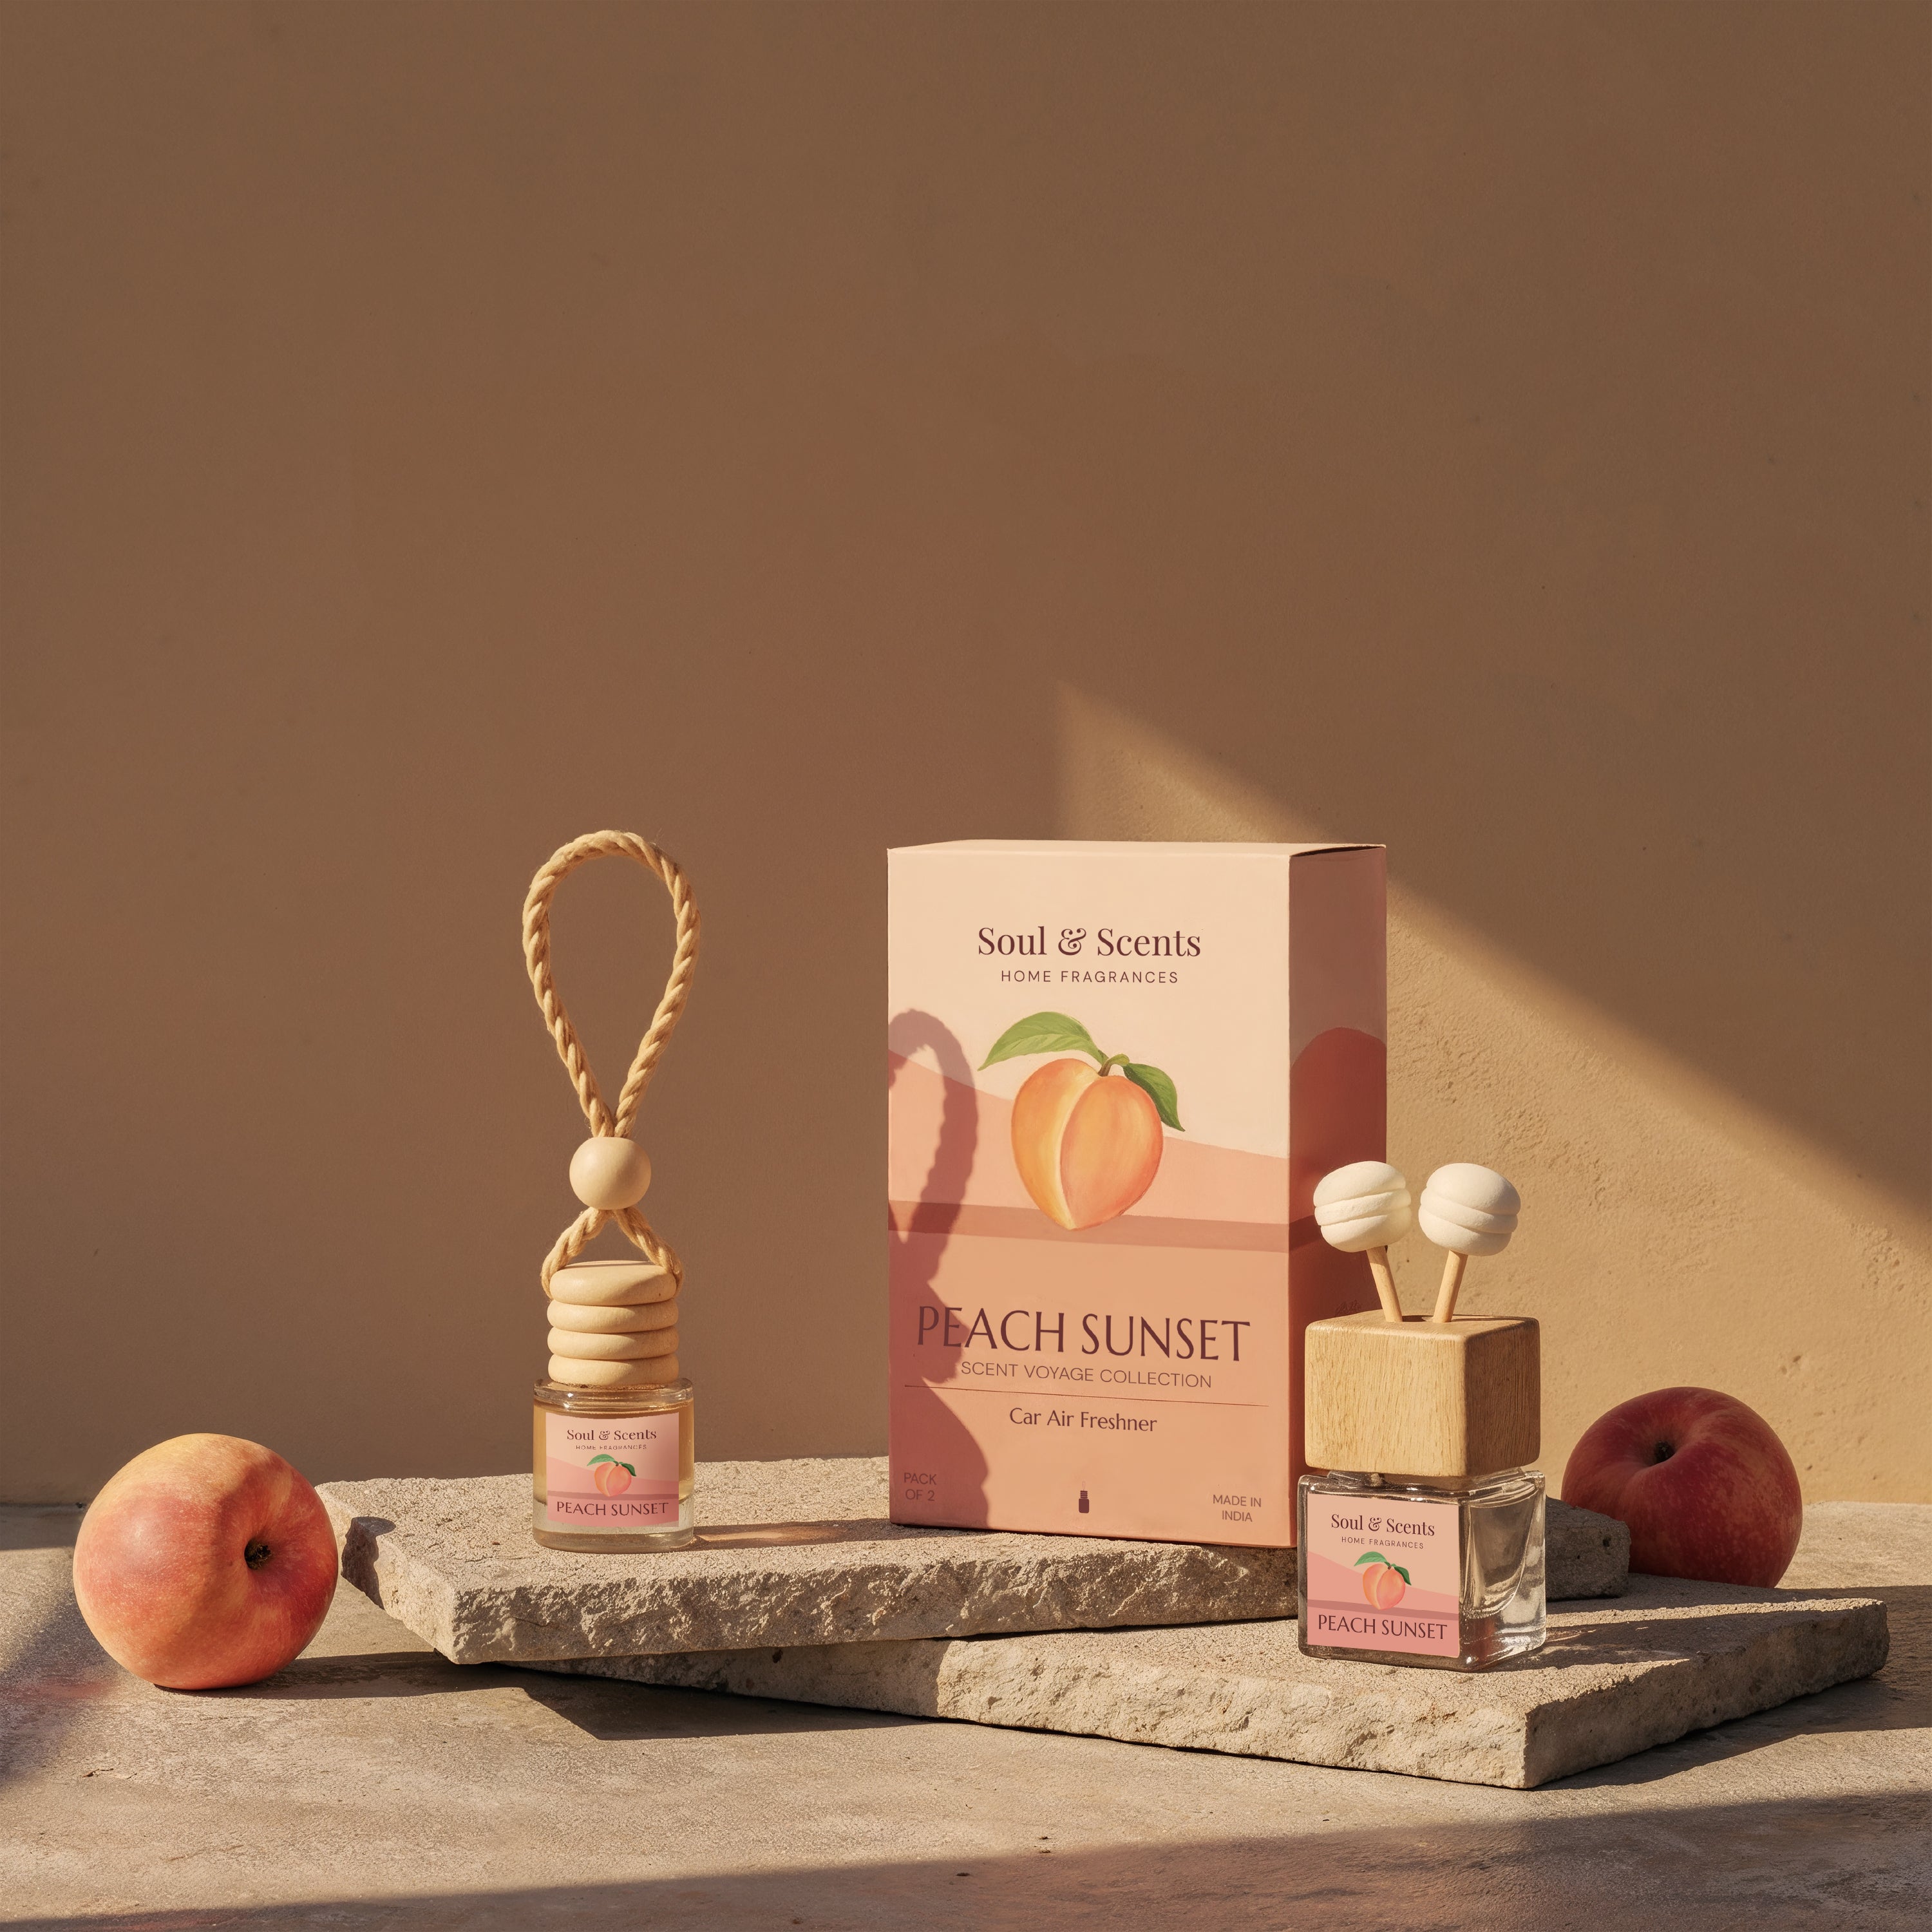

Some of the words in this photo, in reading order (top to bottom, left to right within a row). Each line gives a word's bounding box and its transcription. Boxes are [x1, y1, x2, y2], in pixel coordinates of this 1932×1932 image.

[978, 925, 1047, 956] Soul
[1057, 928, 1086, 956] &
[1097, 928, 1201, 957] Scents
[1001, 970, 1051, 982] HOME
[1061, 971, 1178, 983] FRAGRANCES
[917, 1305, 1065, 1352] PEACH
[1081, 1313, 1250, 1361] SUNSET
[961, 1361, 1018, 1378] SCENT
[1023, 1364, 1094, 1381] VOYAGE
[1100, 1368, 1211, 1388] COLLECTION
[1009, 1407, 1041, 1425] Car
[1046, 1410, 1074, 1427] Air
[1081, 1412, 1157, 1432] Freshner
[567, 1429, 594, 1441] Soul
[598, 1430, 611, 1441] &
[614, 1429, 657, 1441] Scents
[904, 1472, 937, 1485] PACK
[905, 1489, 923, 1501] OF
[927, 1490, 935, 1501] 2
[1213, 1495, 1247, 1506] MADE
[1250, 1497, 1262, 1508] IN
[556, 1501, 607, 1515] PEACH
[611, 1502, 669, 1516] SUNSET
[1222, 1510, 1253, 1522] INDIA
[1331, 1513, 1363, 1530] Soul
[1368, 1517, 1382, 1531] &
[1387, 1519, 1435, 1536] Scents
[1369, 1539, 1423, 1549] FRAGRANCES
[1318, 1615, 1376, 1634] PEACH
[1381, 1619, 1448, 1640] SUNSET
